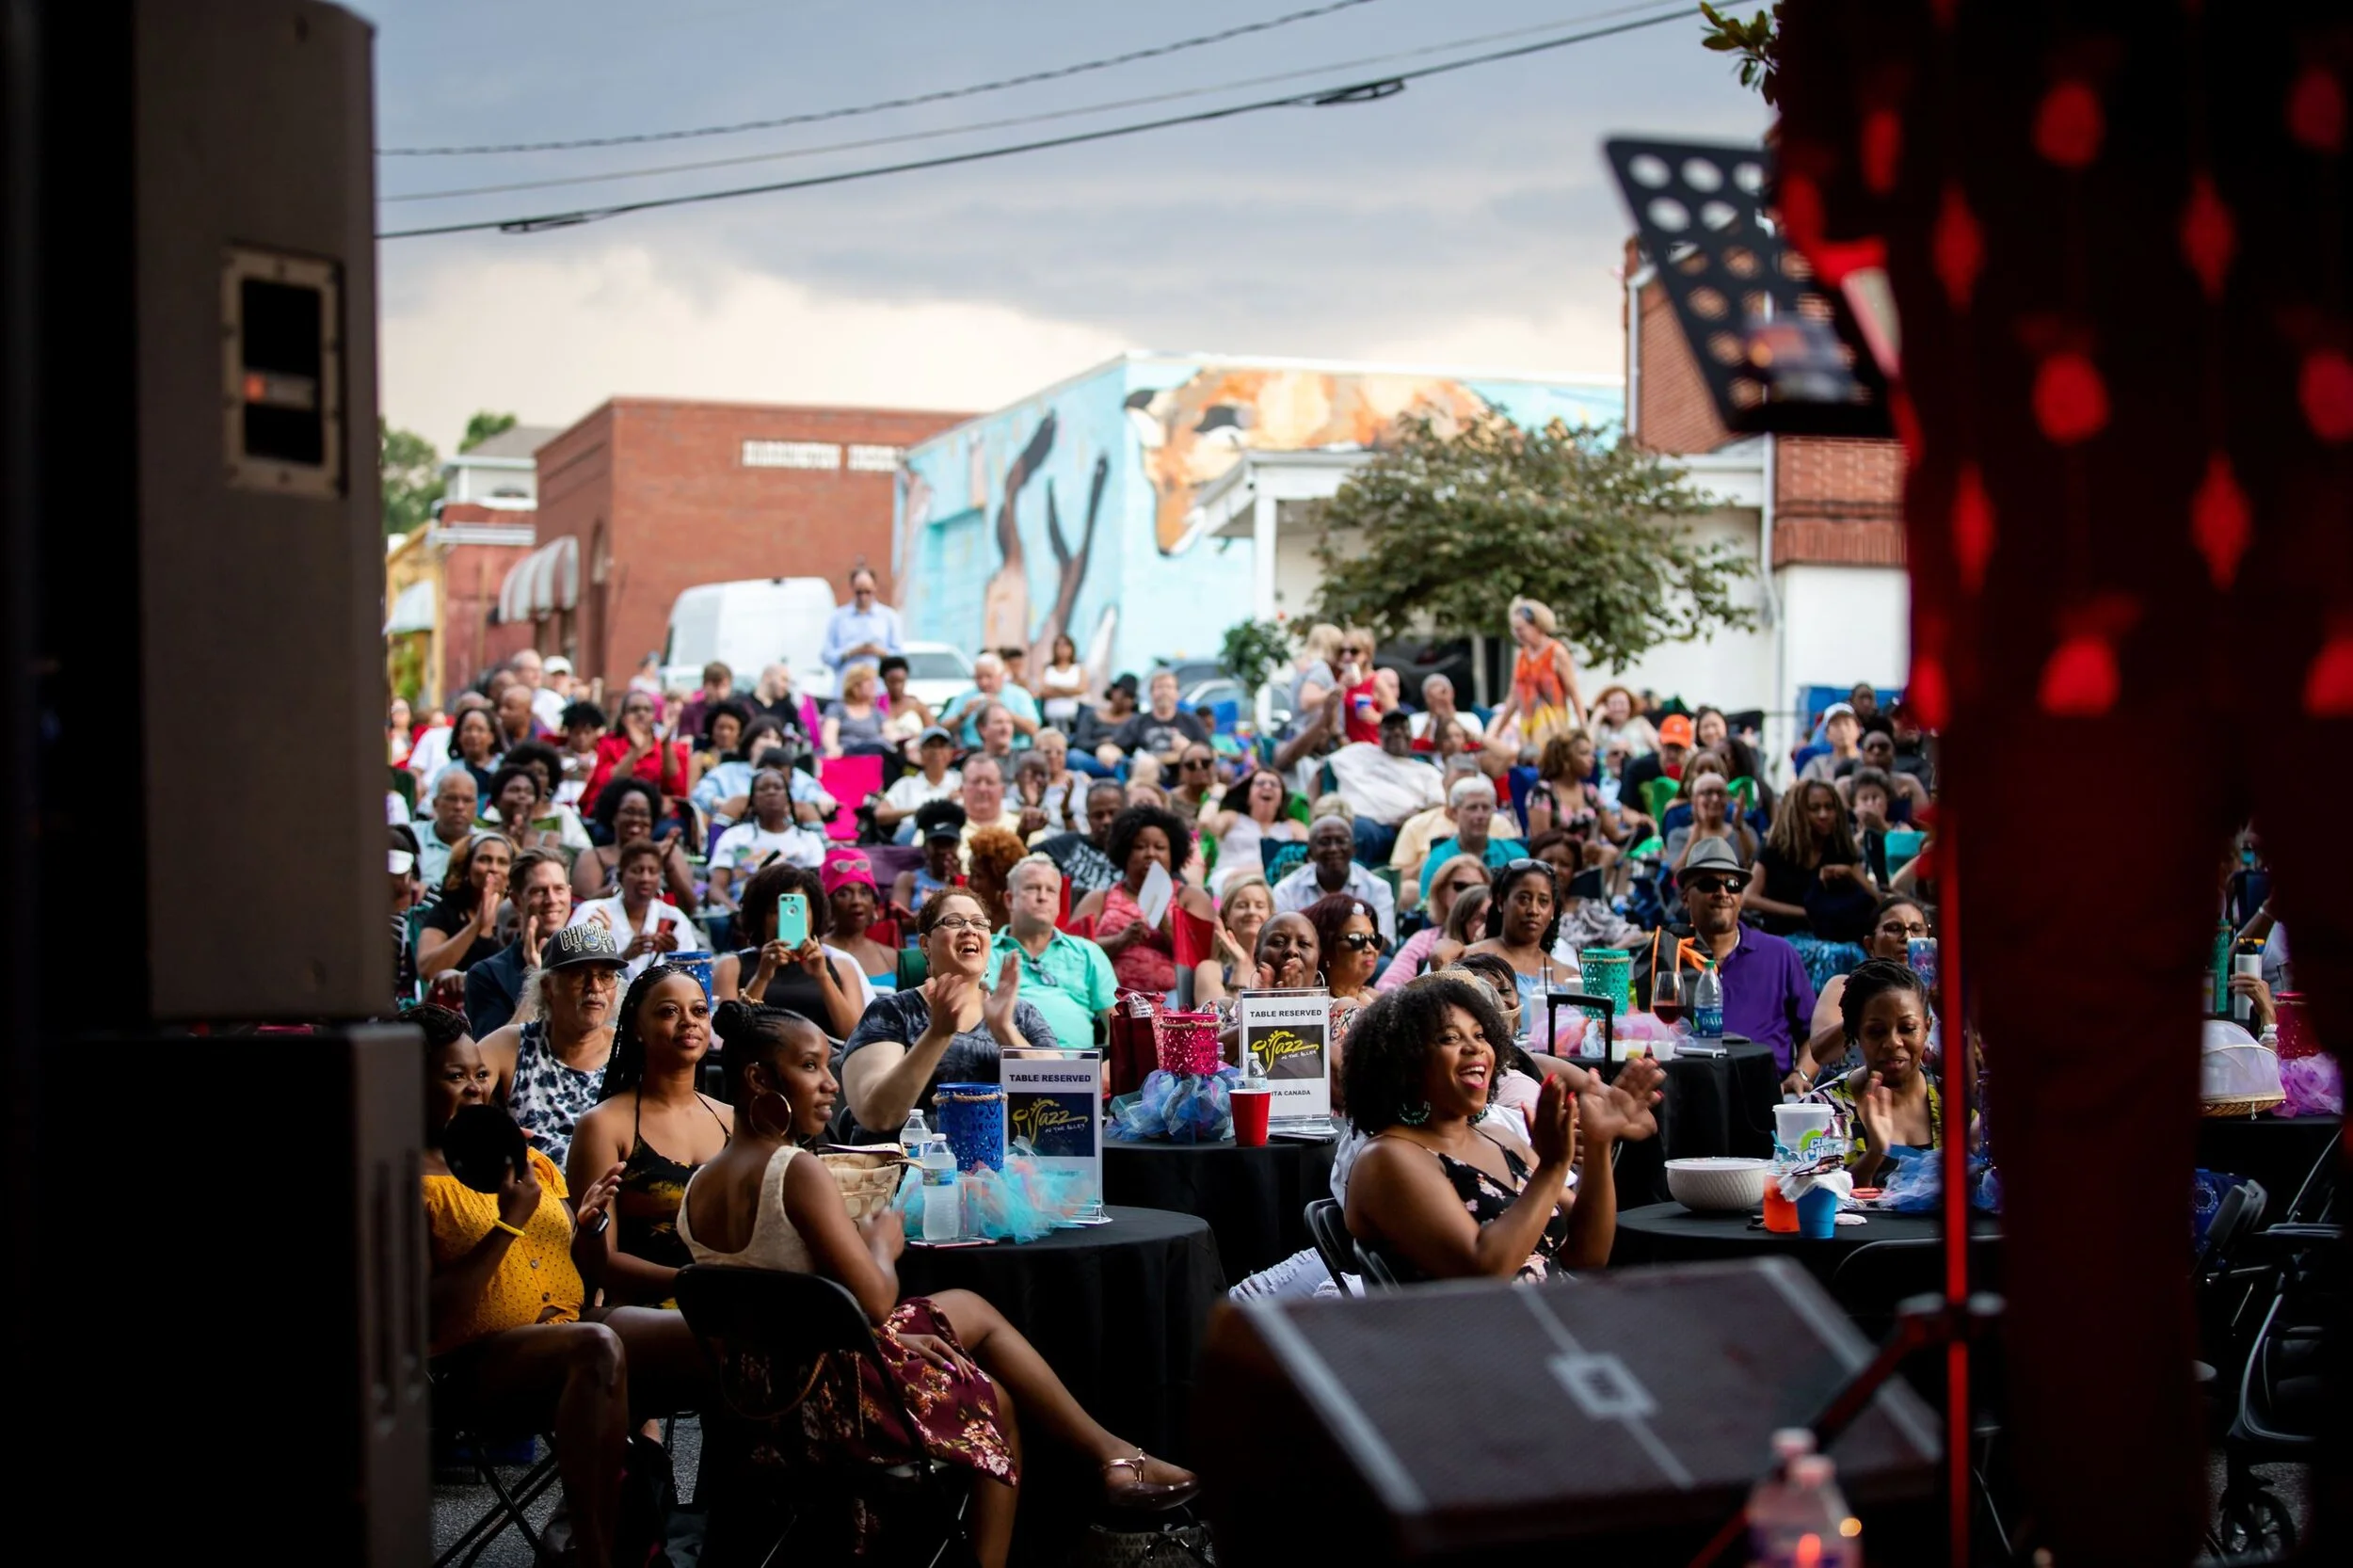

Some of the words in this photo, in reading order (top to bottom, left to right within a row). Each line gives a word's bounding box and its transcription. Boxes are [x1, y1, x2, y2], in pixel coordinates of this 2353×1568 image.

[1264, 1032, 1320, 1073] Jazz
[1009, 1074, 1039, 1082] TABLE
[1041, 1074, 1091, 1082] RESERVED
[1028, 1097, 1089, 1144] Jazz
